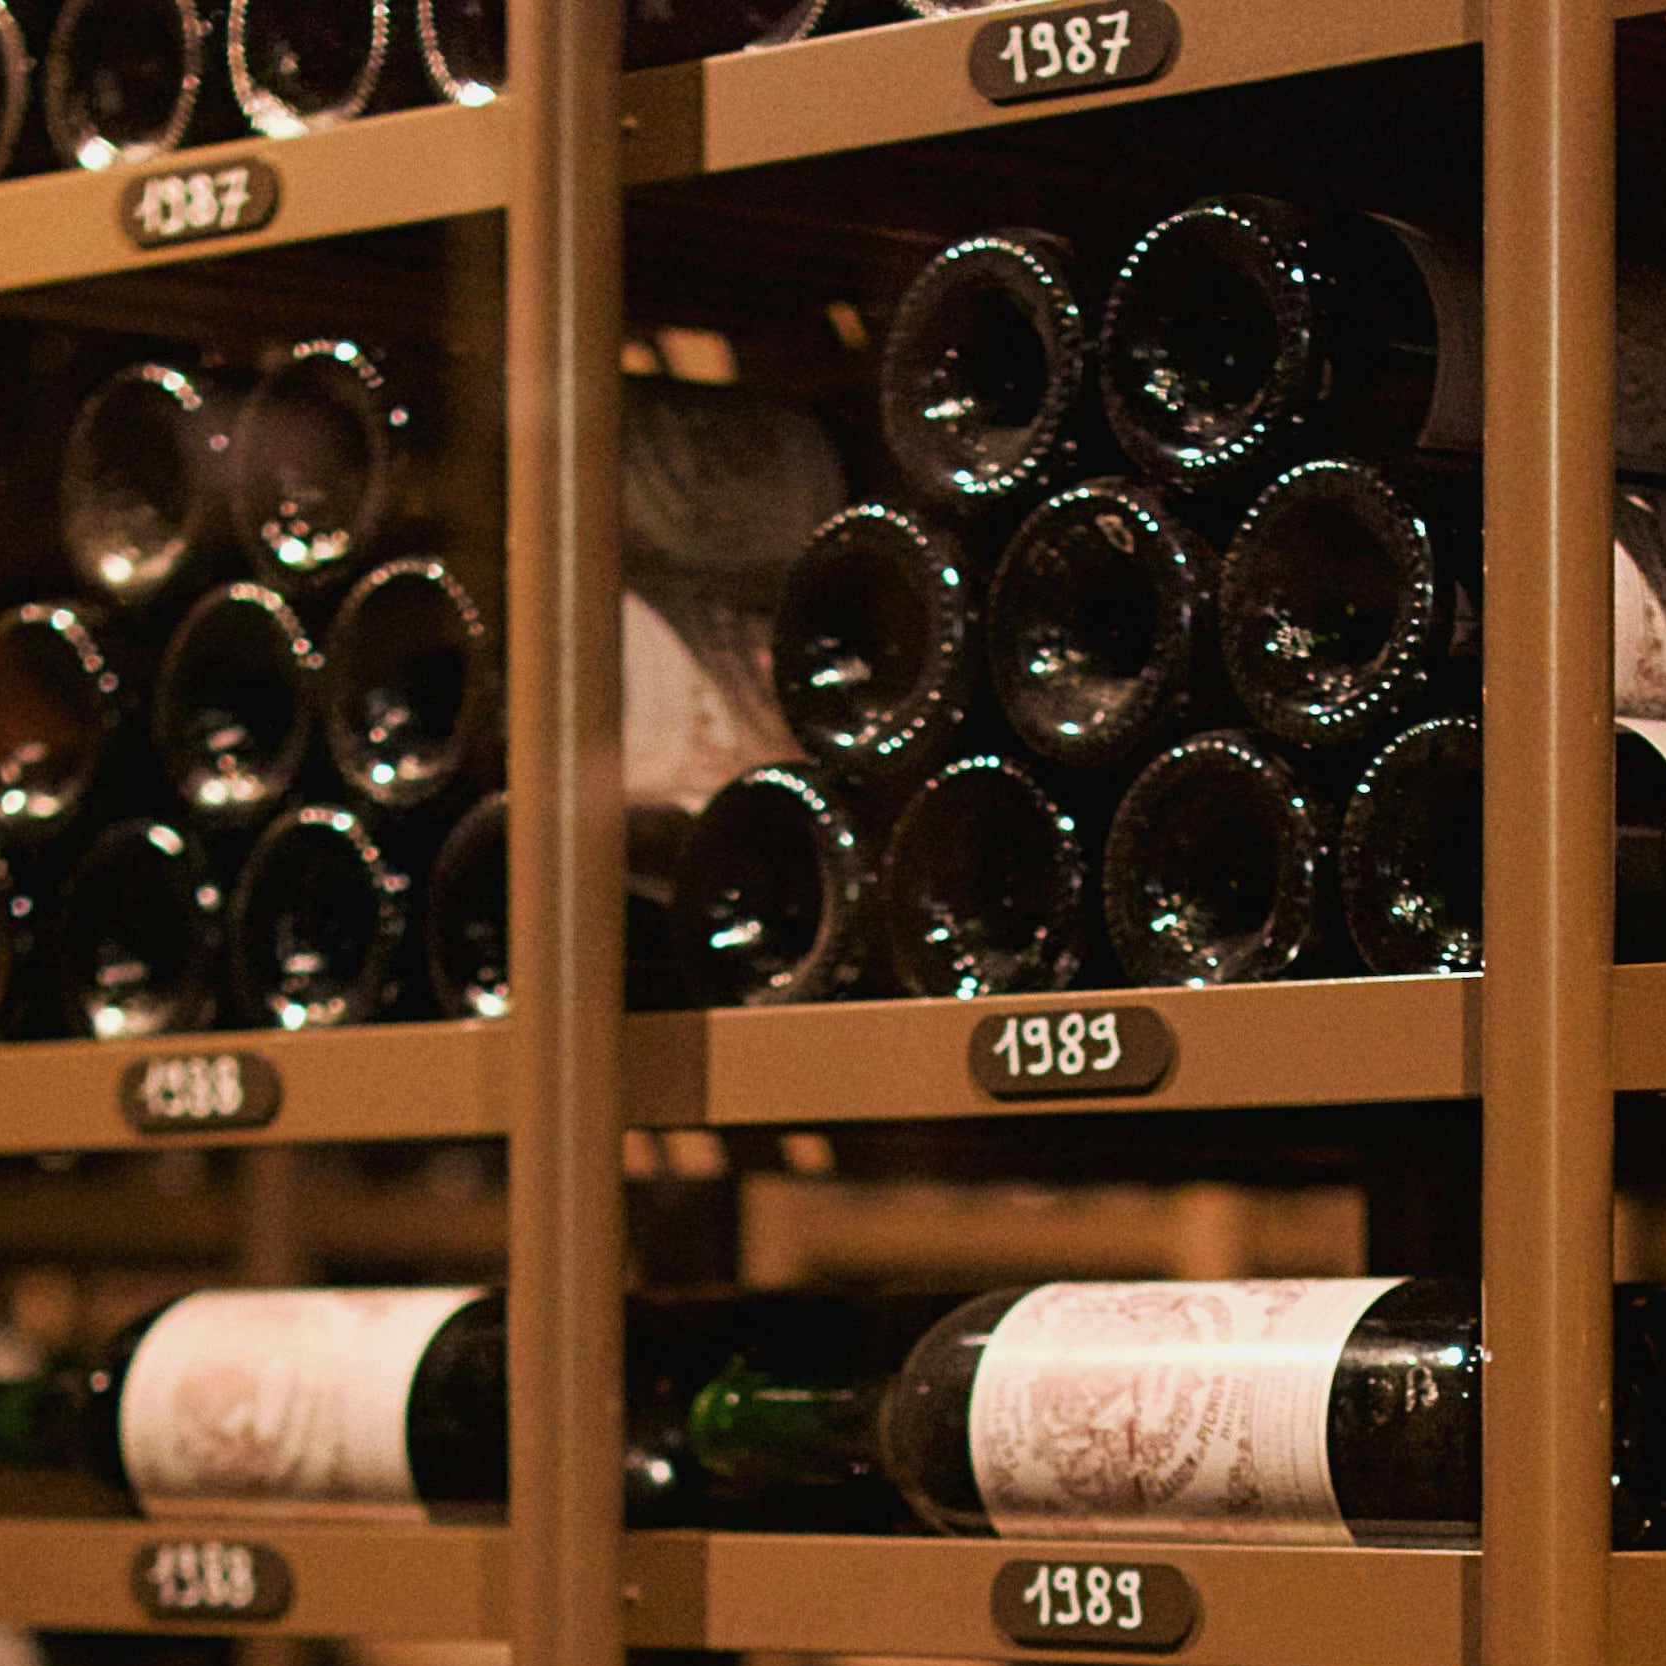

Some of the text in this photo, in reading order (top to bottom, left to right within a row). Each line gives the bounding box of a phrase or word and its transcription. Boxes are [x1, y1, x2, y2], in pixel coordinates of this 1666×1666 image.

[999, 10, 1131, 84] 1987
[136, 169, 250, 235] 1987
[993, 1012, 1122, 1076] 1989
[1023, 1565, 1143, 1630] 1989
